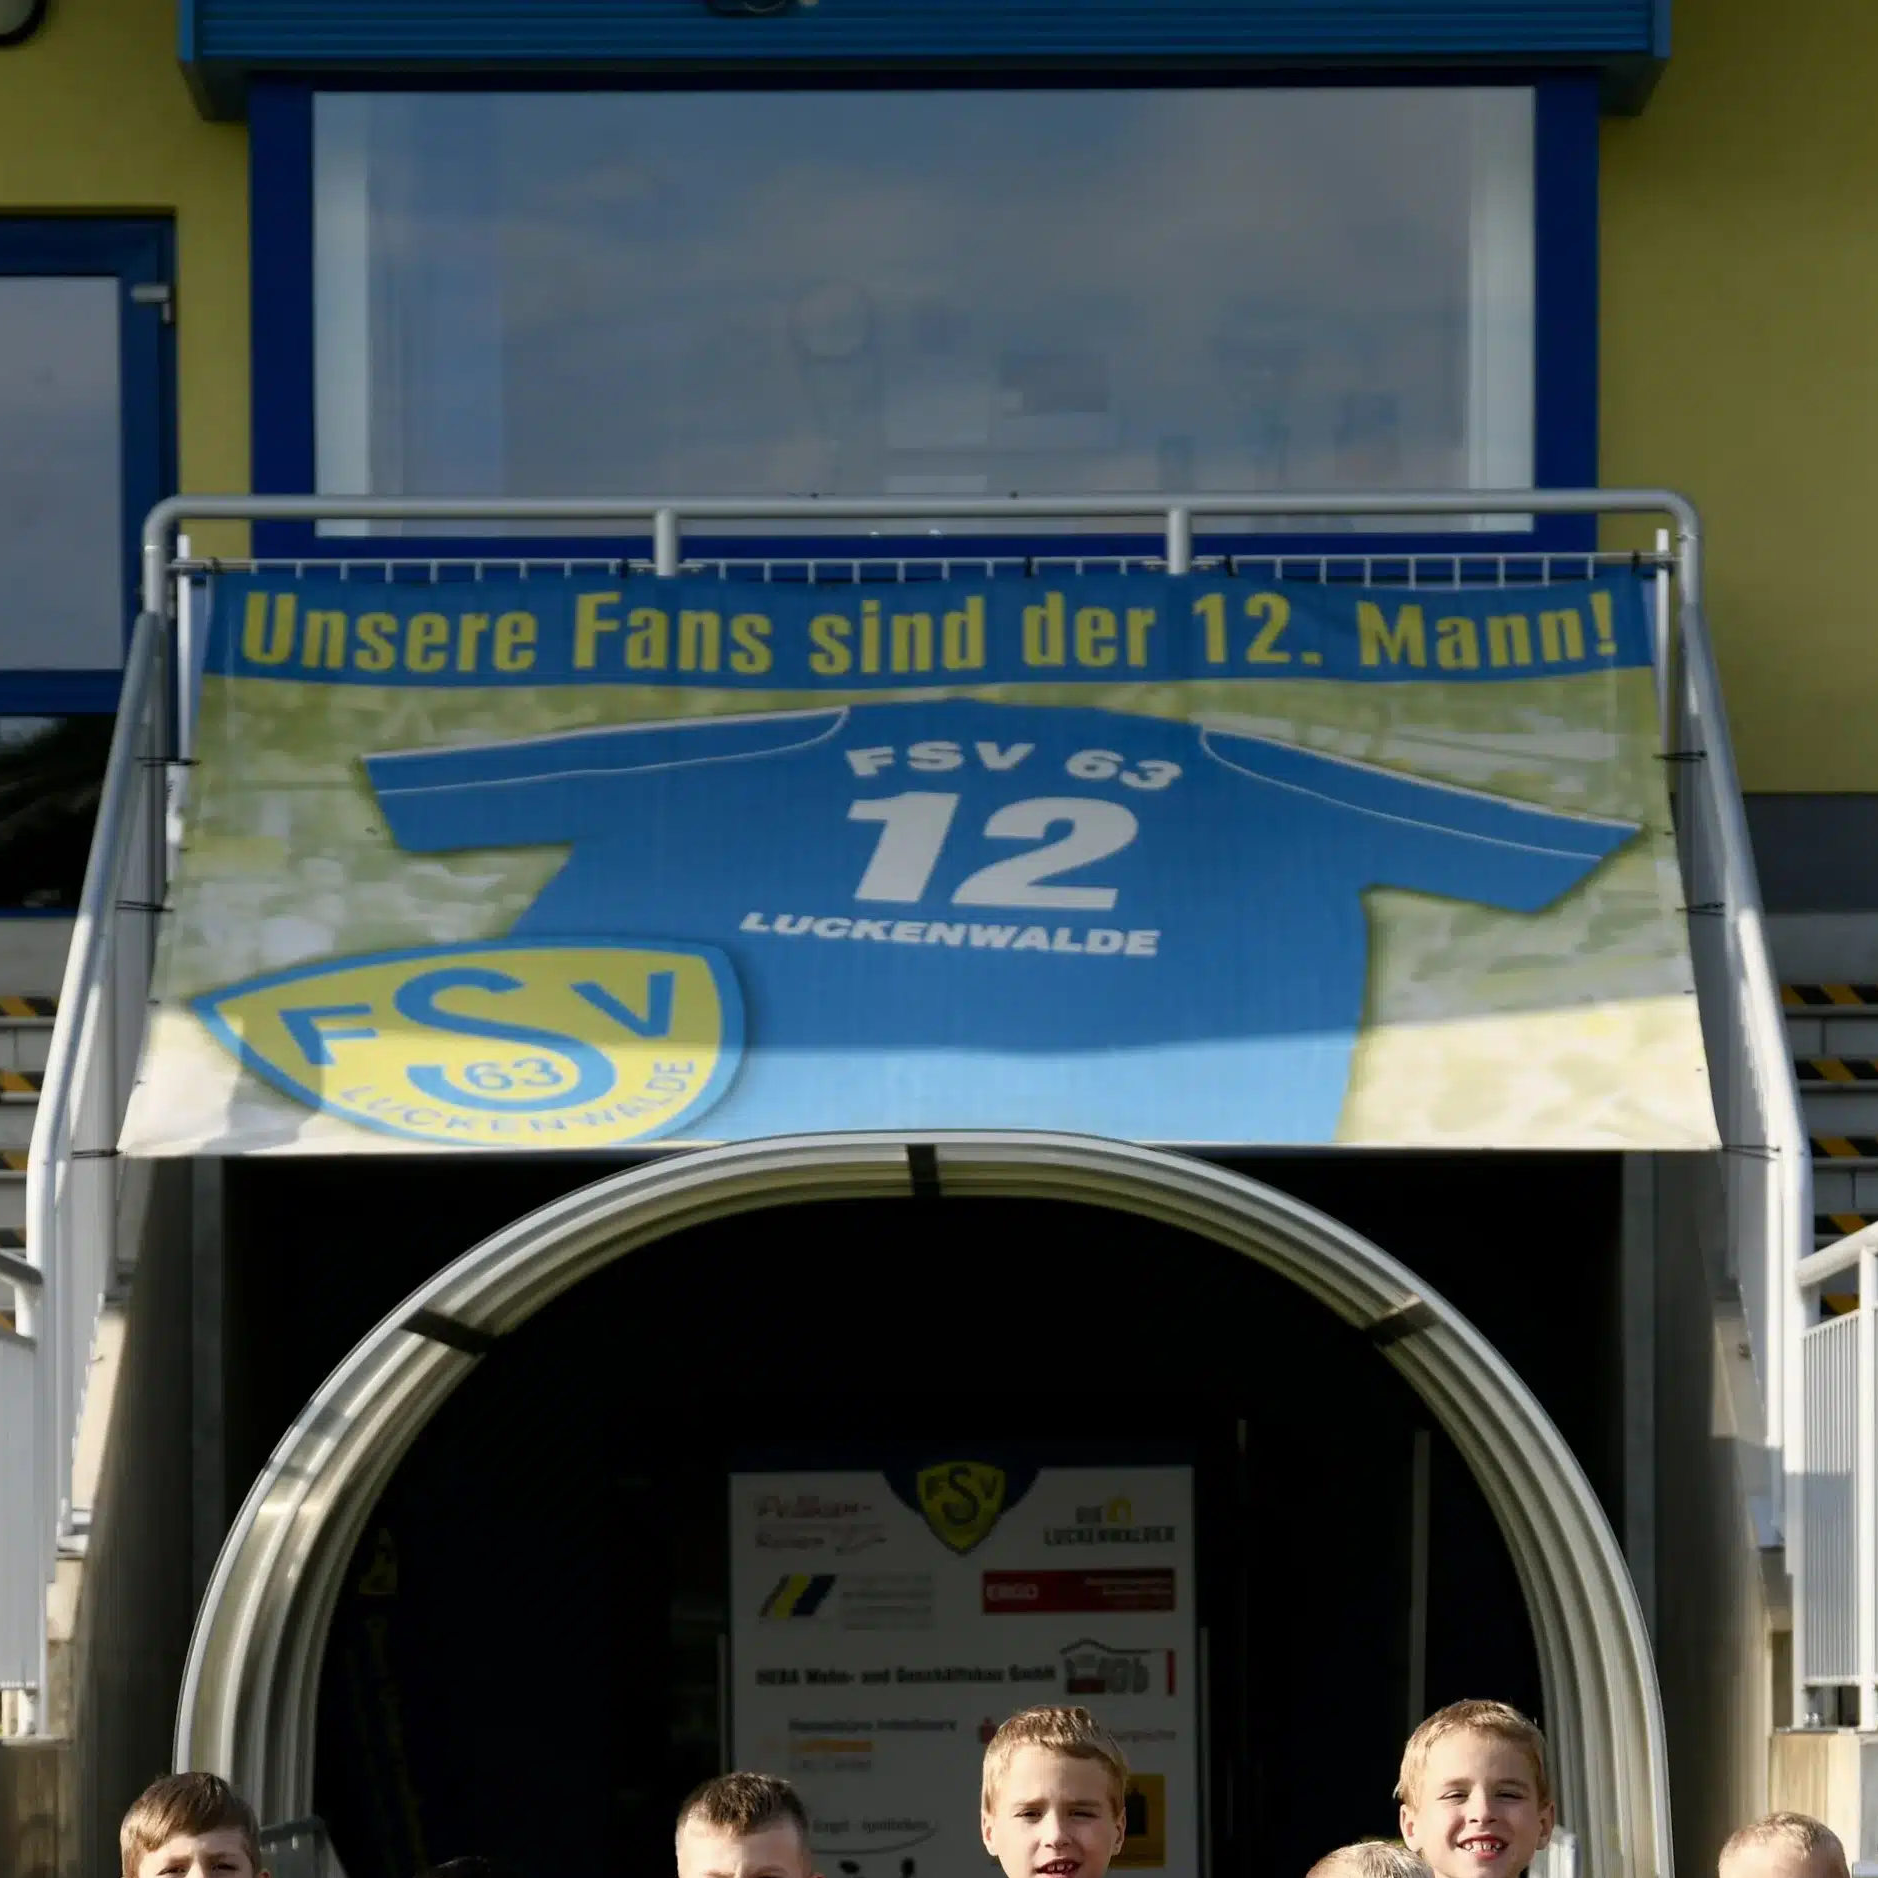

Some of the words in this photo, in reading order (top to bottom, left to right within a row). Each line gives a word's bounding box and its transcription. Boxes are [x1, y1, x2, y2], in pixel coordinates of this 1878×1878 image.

[242, 592, 538, 673] Unsere
[573, 592, 772, 674] Fans
[809, 596, 985, 675] sind
[1023, 592, 1155, 667] der
[1192, 592, 1322, 664] 12.
[1357, 591, 1617, 671] Mann!
[846, 741, 1035, 777] FSV
[1065, 750, 1182, 790] 63
[847, 792, 1137, 911] 12
[739, 913, 1160, 956] LUCKENWALDE
[280, 967, 675, 1112] FSV
[463, 1057, 563, 1094] 63
[340, 1059, 695, 1131] LUCKENWALDE
